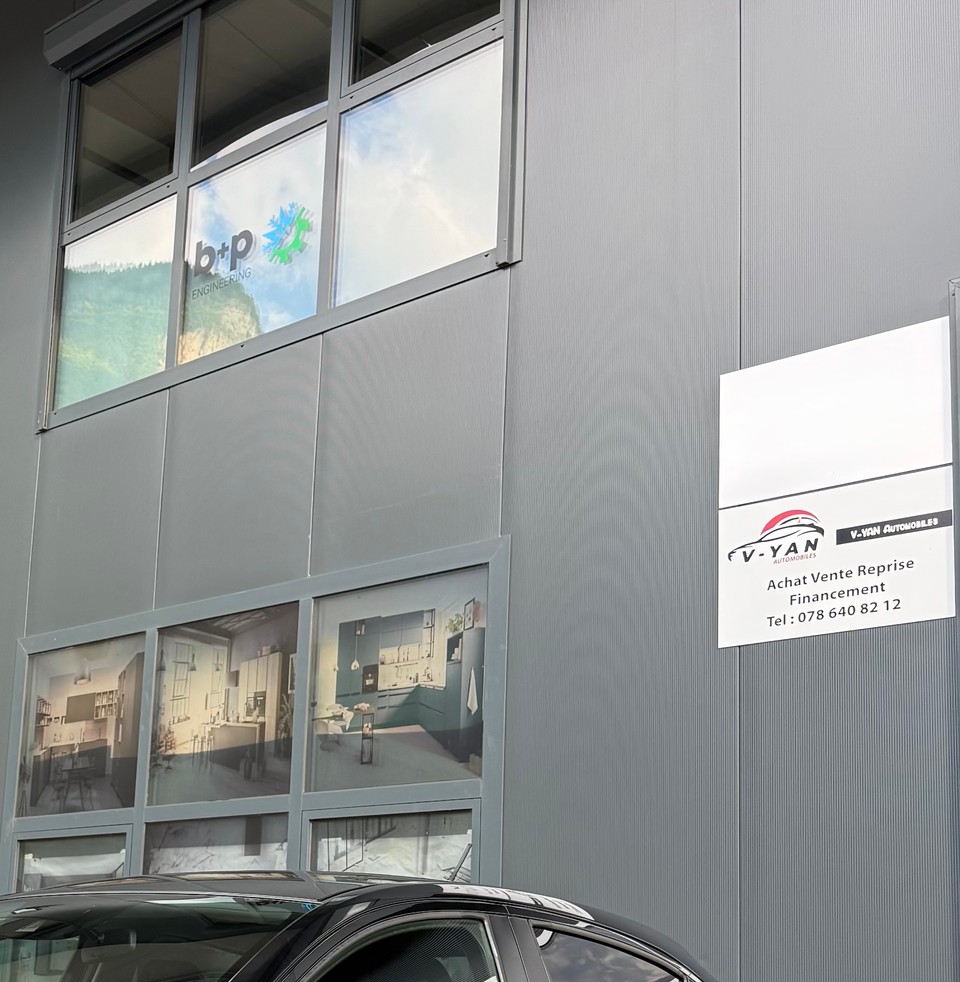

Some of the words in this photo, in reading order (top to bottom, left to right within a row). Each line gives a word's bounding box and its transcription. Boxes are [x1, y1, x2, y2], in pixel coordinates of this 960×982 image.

[194, 229, 254, 277] b+p
[191, 267, 252, 300] ENGINEERING
[850, 525, 881, 539] V-YAN
[773, 552, 817, 565] AUTOMOBILES
[767, 575, 808, 591] Achat
[811, 568, 854, 584] Vente
[857, 558, 915, 577] Reprise
[789, 581, 886, 606] Financement
[798, 609, 824, 623] 078
[828, 604, 856, 619] 640
[860, 601, 878, 614] 82
[884, 598, 902, 611] 12
